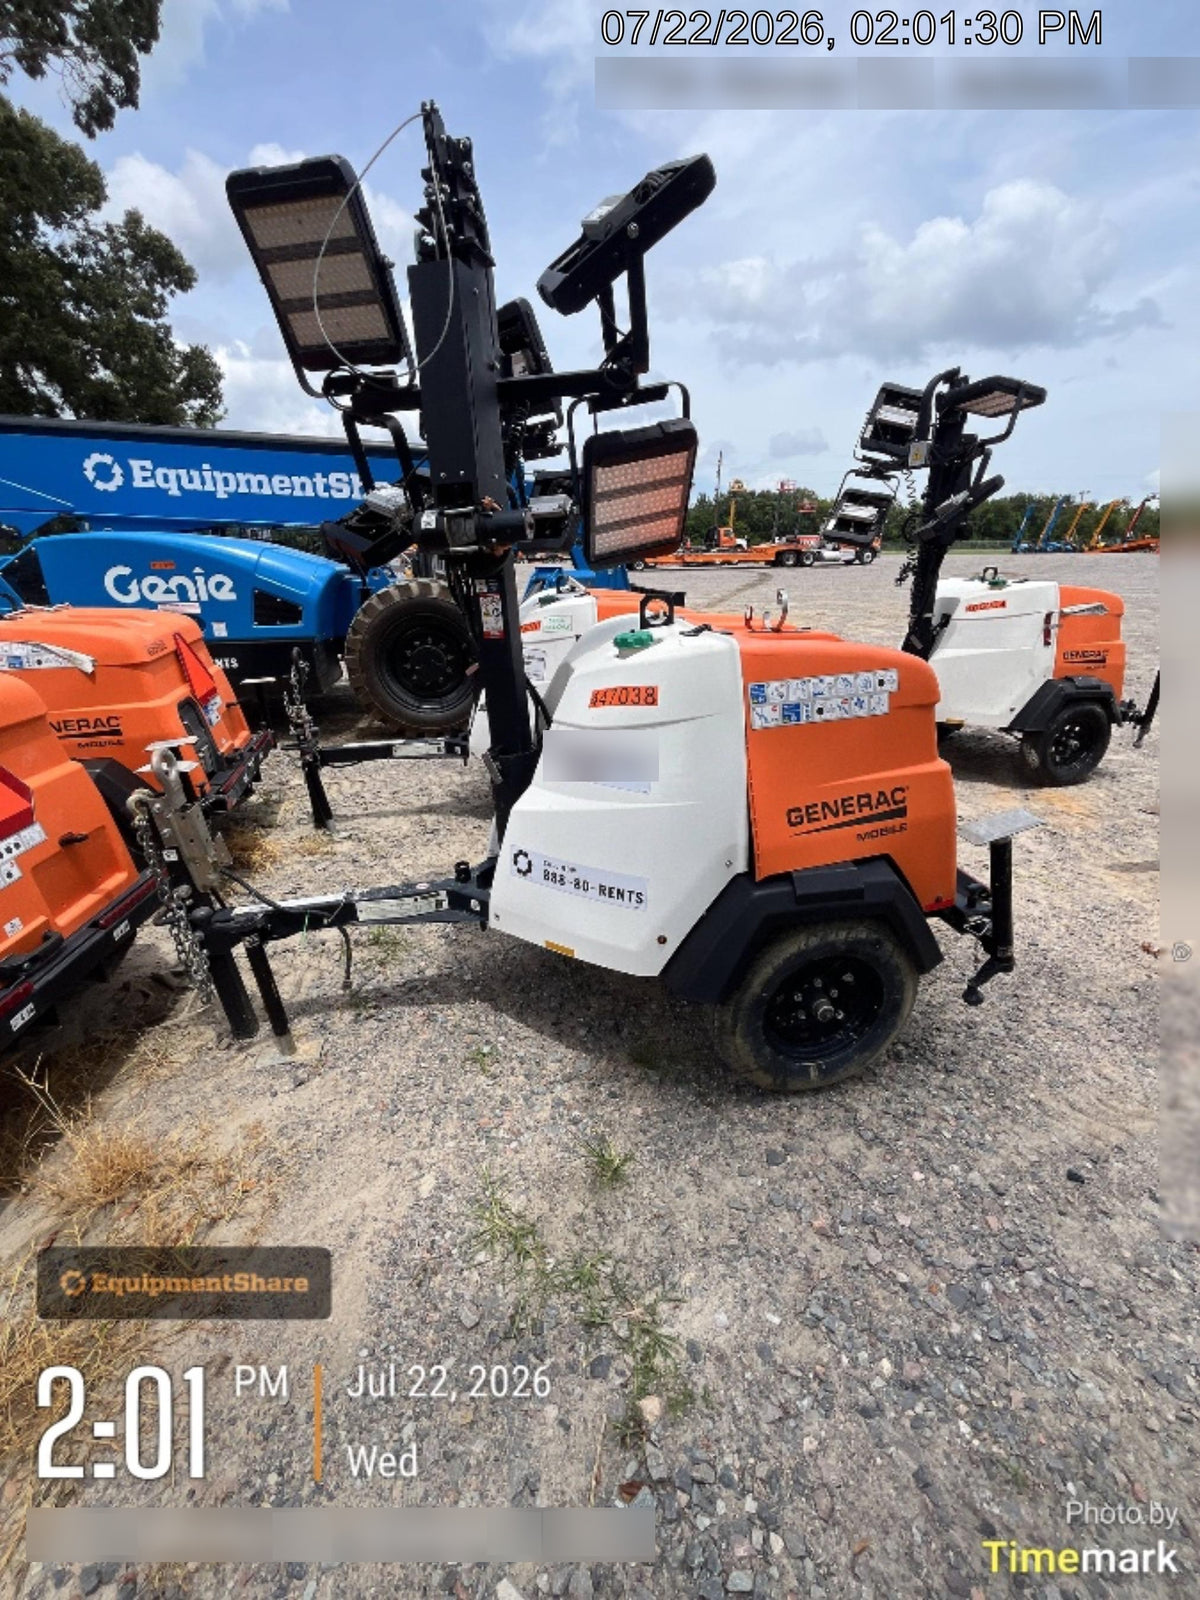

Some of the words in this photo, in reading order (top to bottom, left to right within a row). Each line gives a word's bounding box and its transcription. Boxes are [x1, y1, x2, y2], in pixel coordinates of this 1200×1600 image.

[104, 565, 237, 603] Genie
[786, 786, 907, 828] GENERAC
[856, 822, 908, 842] MOBILE
